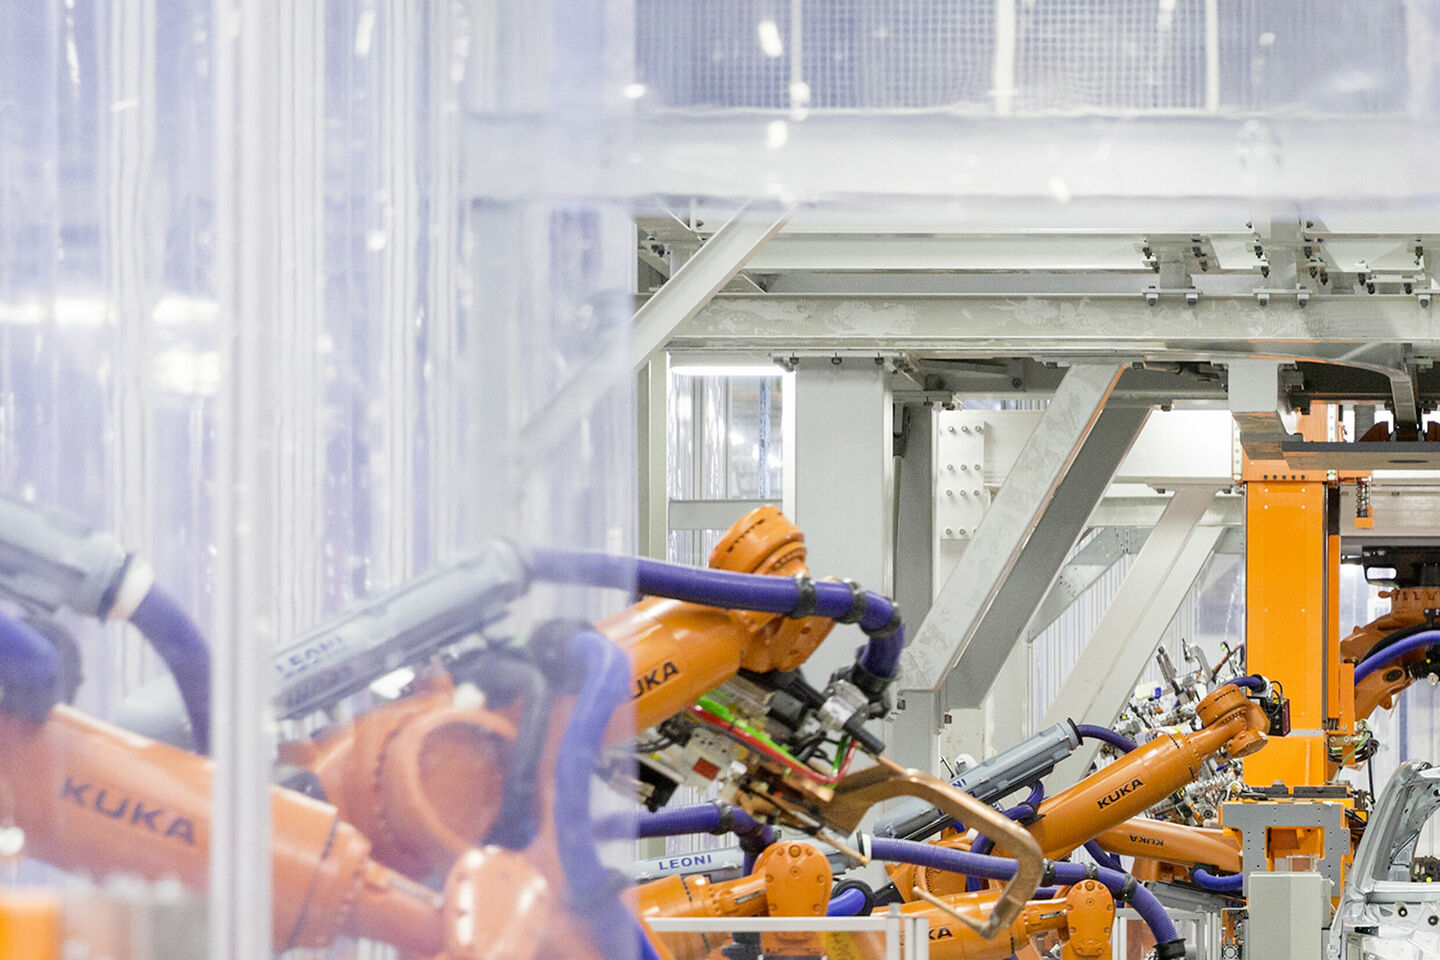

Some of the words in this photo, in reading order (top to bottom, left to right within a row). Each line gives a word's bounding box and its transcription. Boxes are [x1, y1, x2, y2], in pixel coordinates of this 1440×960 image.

[632, 660, 680, 699] UKA
[1097, 778, 1144, 809] KUKA
[60, 776, 197, 846] KUKA
[1129, 834, 1164, 846] KUKA
[658, 854, 712, 870] LEONI
